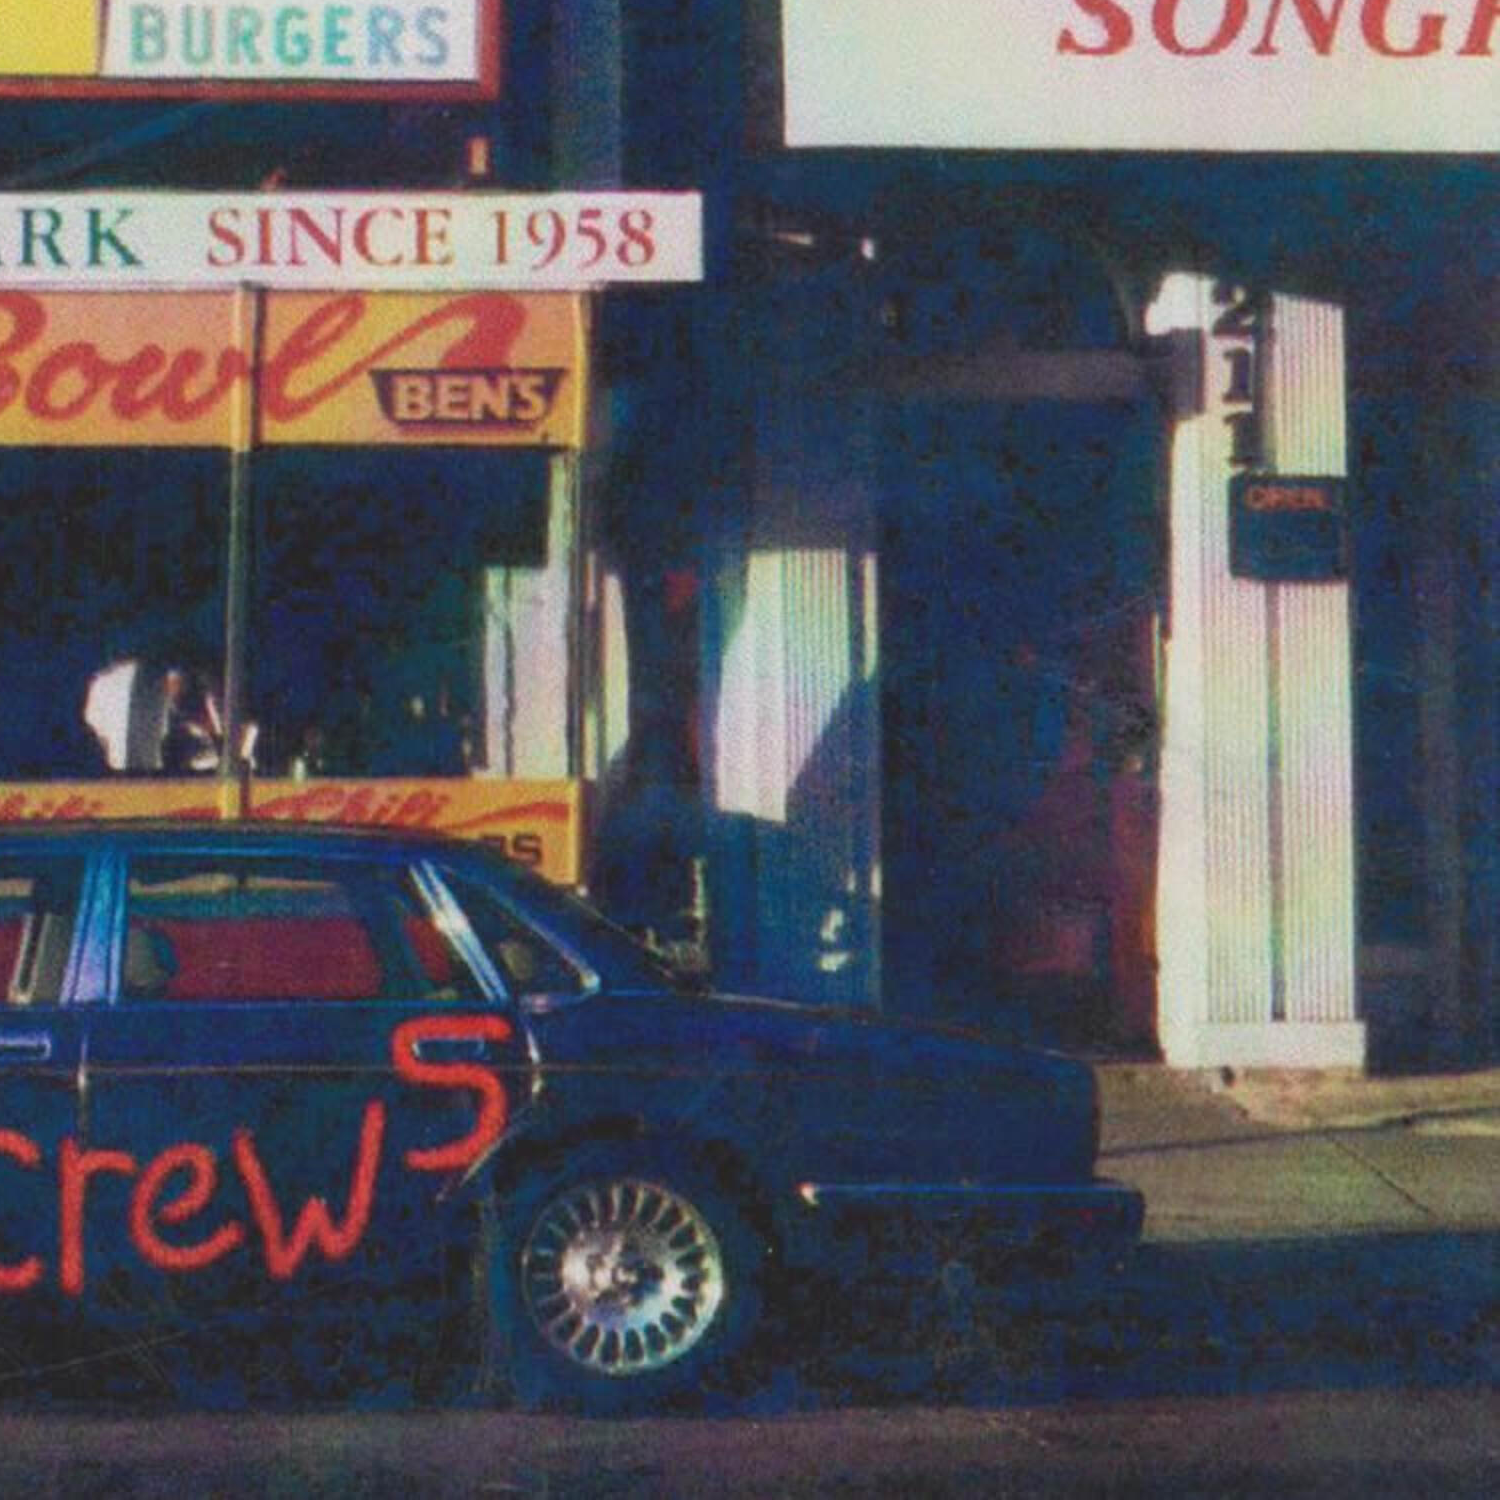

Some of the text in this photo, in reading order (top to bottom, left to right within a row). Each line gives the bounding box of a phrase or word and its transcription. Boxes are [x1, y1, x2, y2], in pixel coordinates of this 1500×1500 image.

[129, 4, 450, 68] BURGERS
[205, 206, 455, 268] SINCE
[492, 207, 657, 269] 1958
